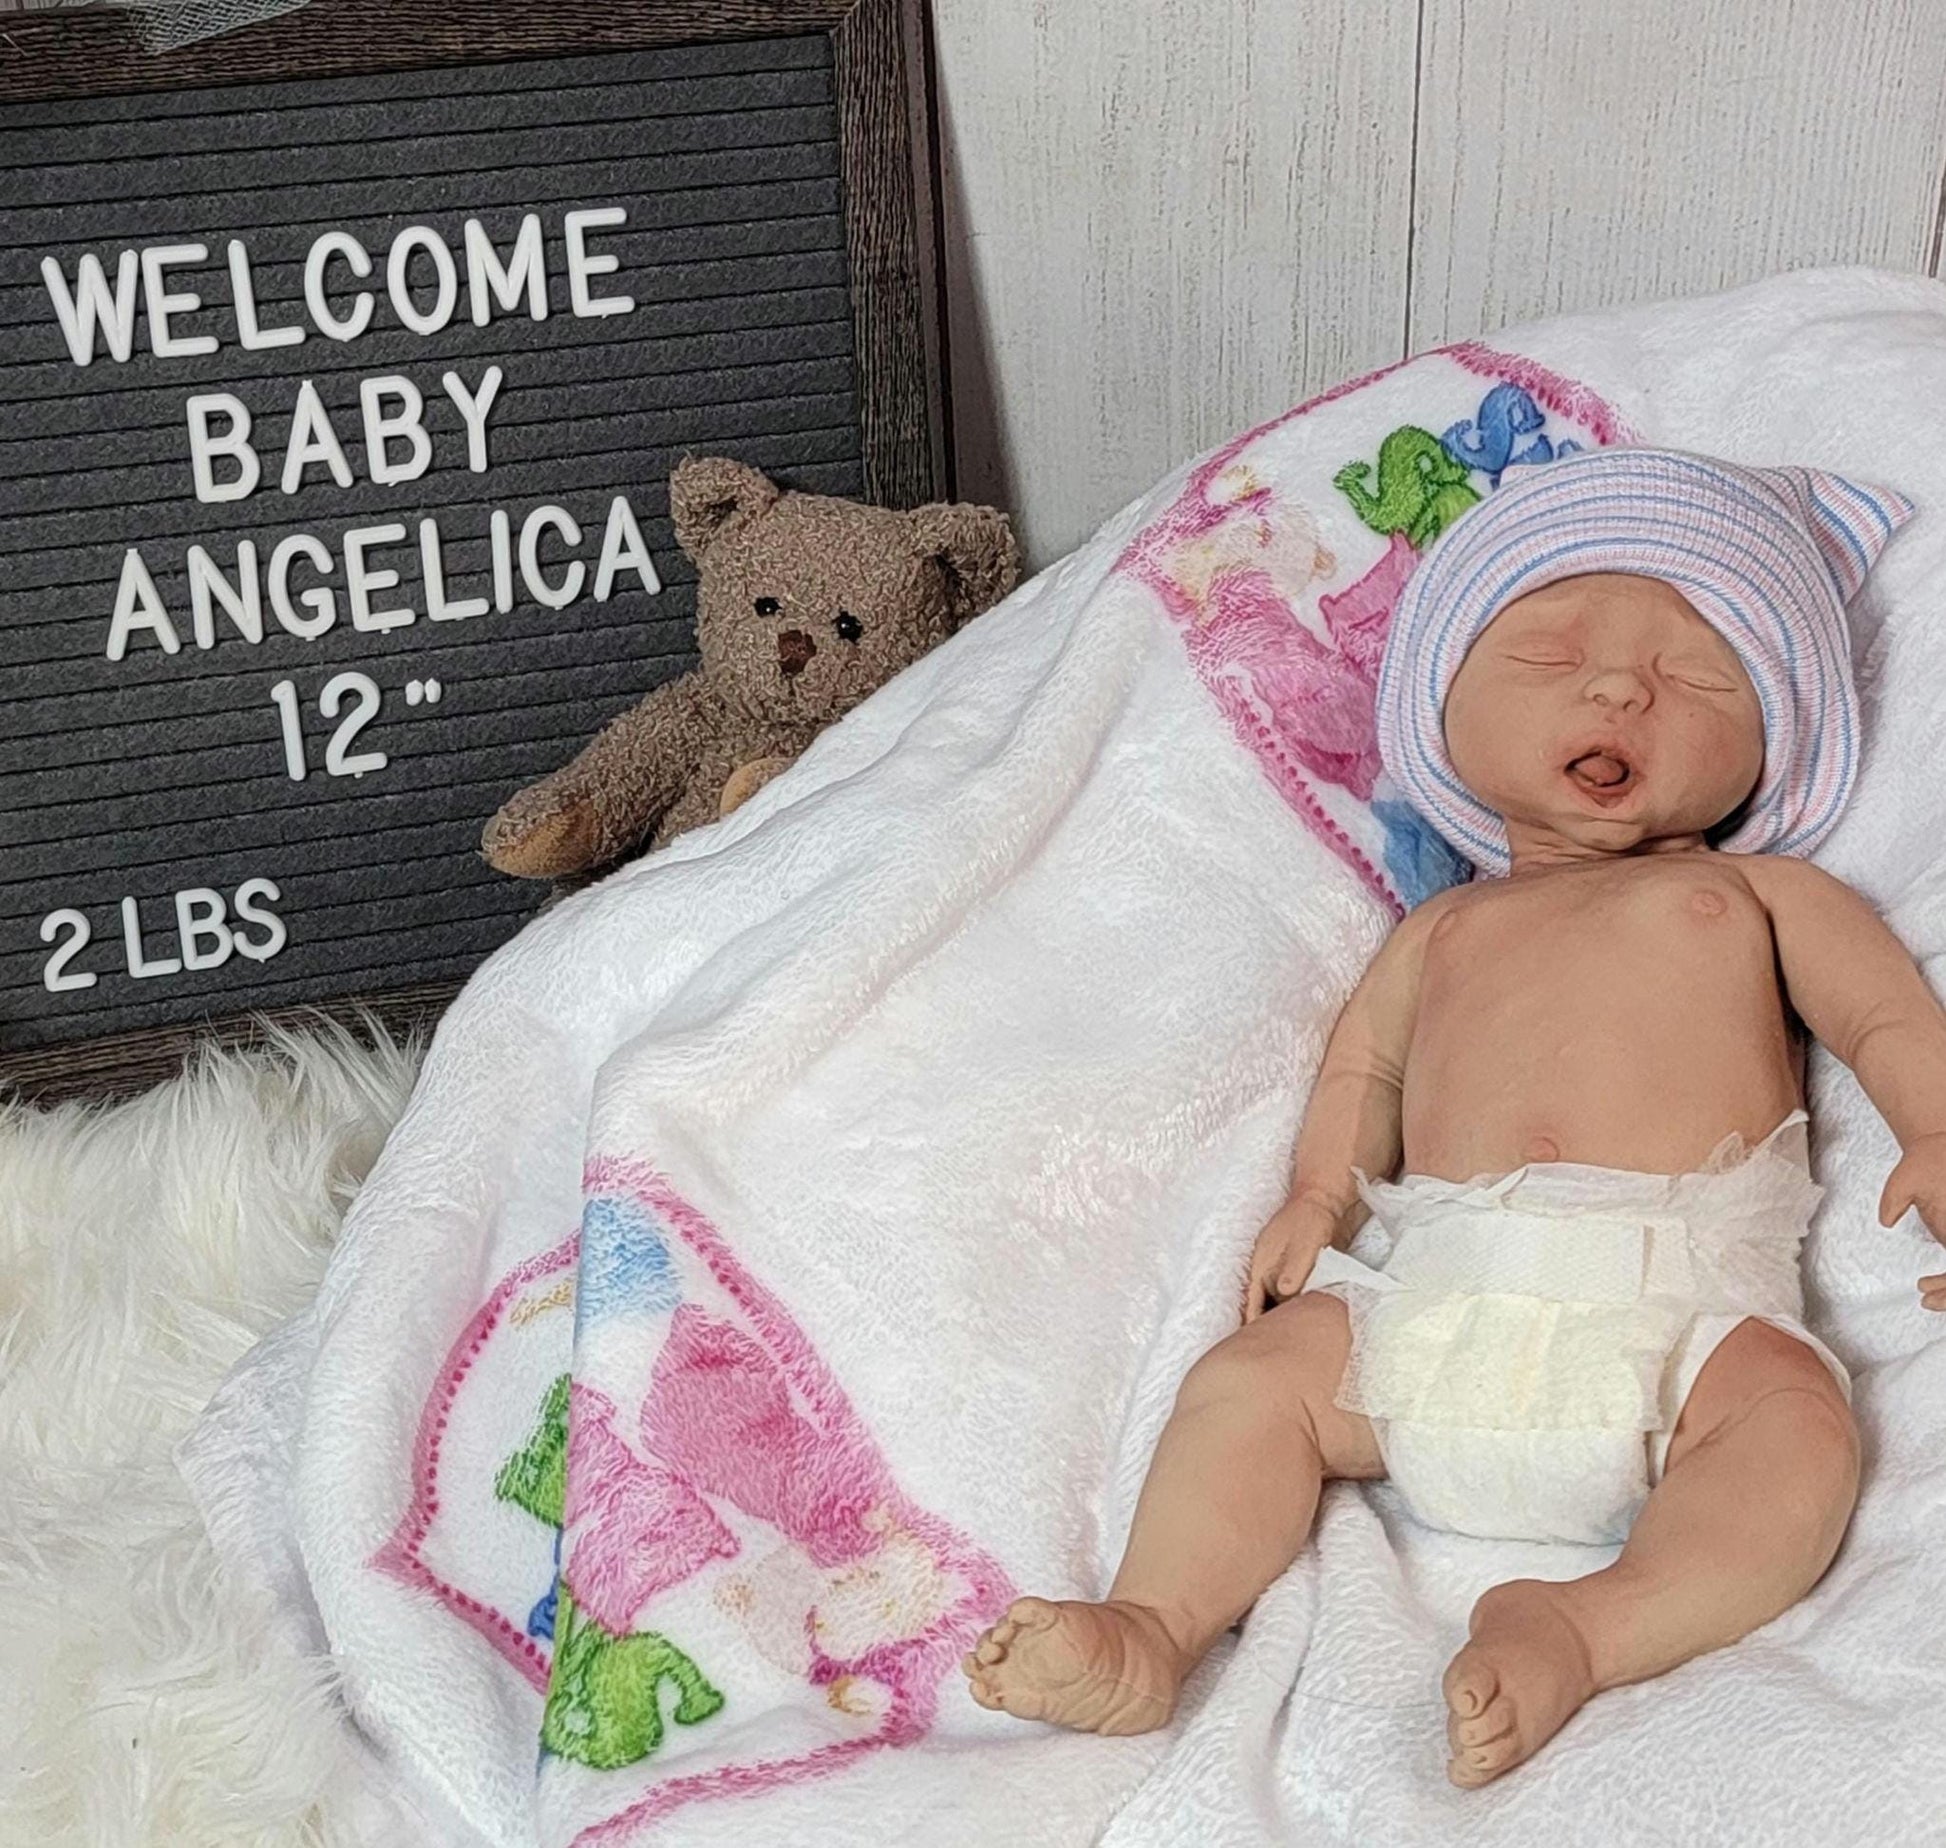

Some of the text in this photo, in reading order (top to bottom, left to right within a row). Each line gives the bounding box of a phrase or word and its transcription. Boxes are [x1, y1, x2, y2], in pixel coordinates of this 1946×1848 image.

[41, 208, 634, 366] WELCOME
[187, 366, 502, 502] BABY
[107, 496, 660, 660] ANGELICA
[41, 879, 285, 991] 2 LBS
